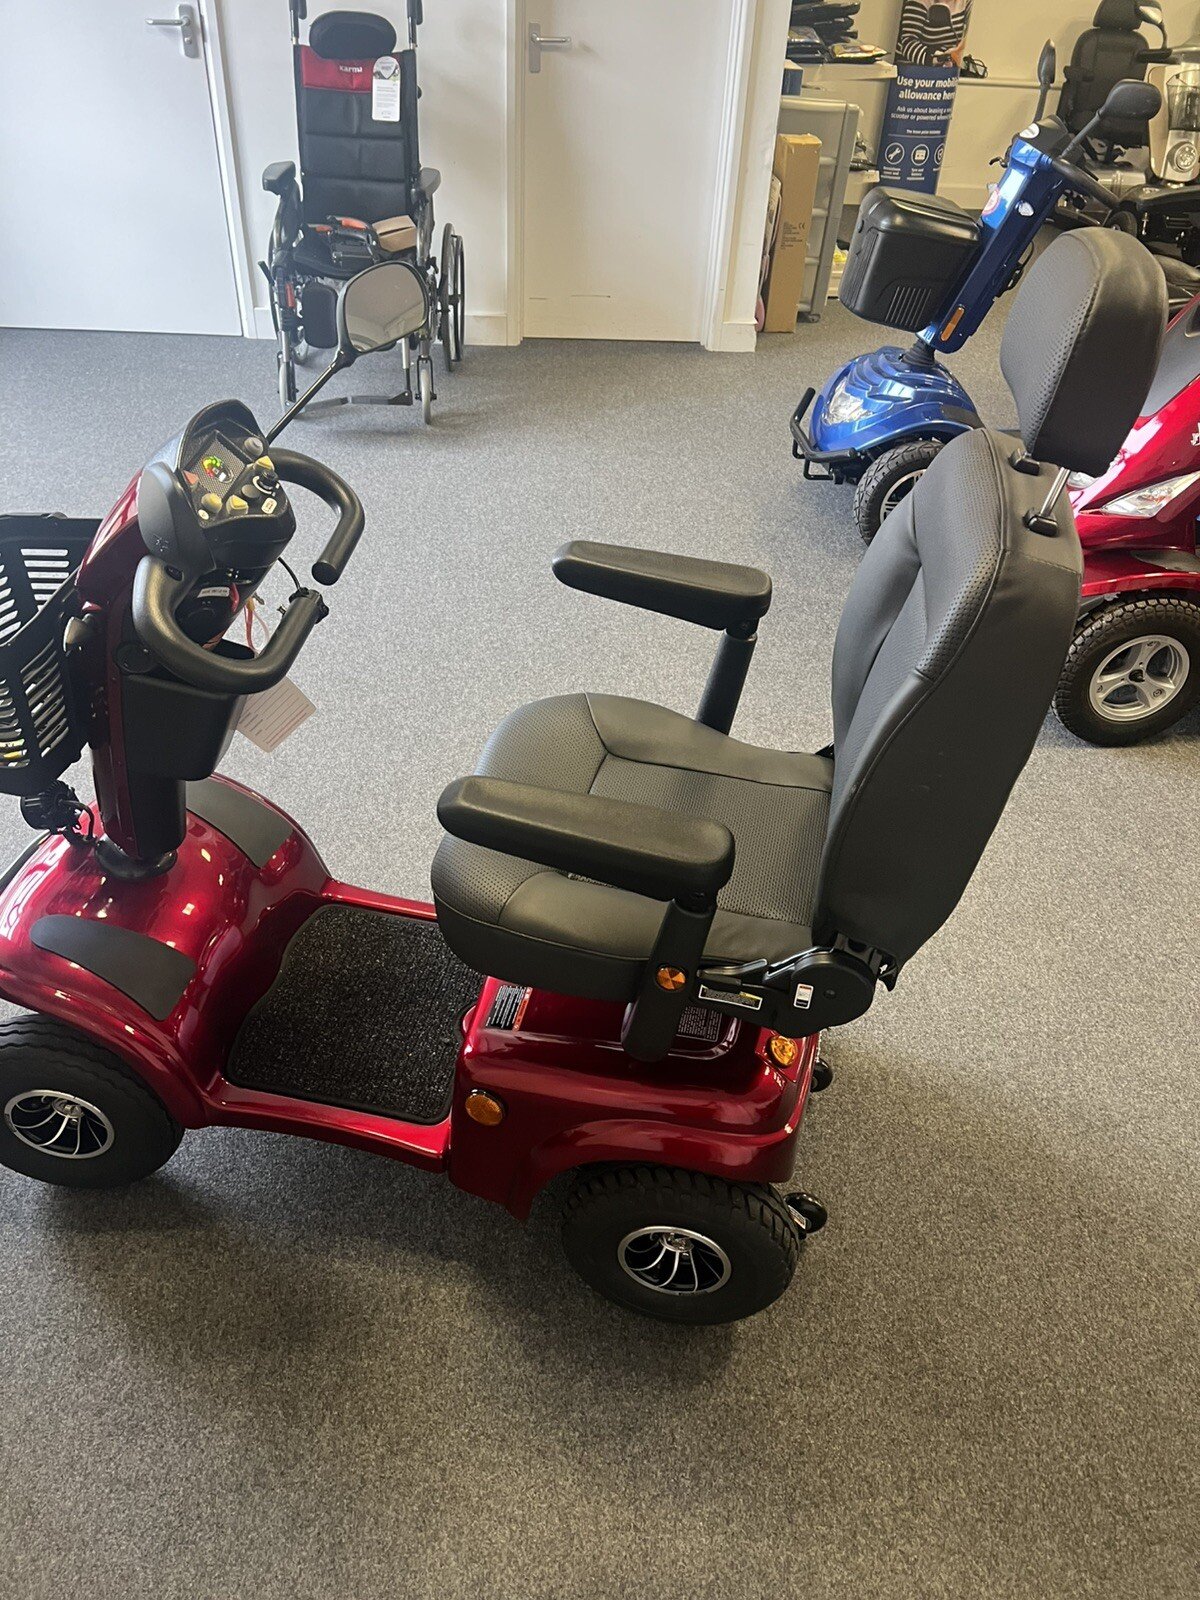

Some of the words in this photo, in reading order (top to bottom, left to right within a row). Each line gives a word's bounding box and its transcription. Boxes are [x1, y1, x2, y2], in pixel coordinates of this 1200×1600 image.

[897, 76, 914, 86] Use
[914, 79, 935, 89] your
[899, 89, 942, 100] allowance
